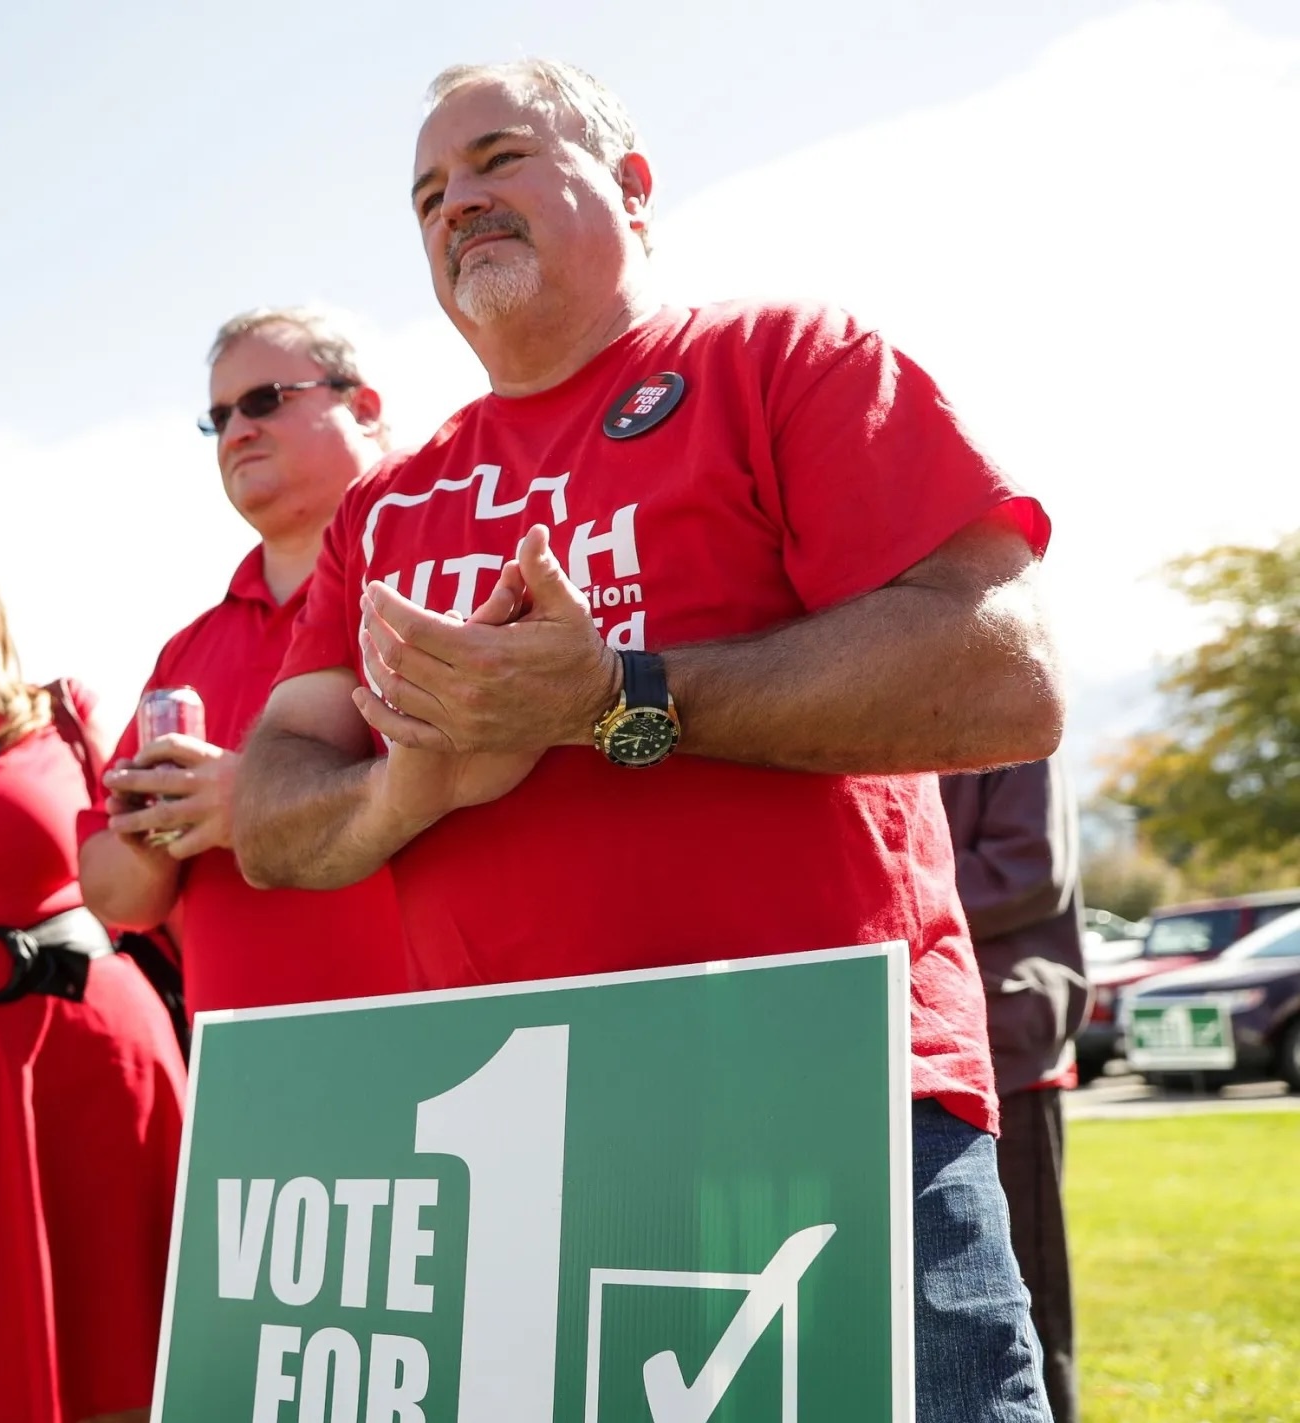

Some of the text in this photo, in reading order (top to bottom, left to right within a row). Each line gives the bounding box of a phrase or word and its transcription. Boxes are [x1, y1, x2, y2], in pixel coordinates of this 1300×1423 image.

[633, 405, 653, 415] ED
[634, 396, 661, 406] FOR
[383, 503, 641, 621] TH
[216, 1176, 439, 1313] VOTE
[414, 1024, 570, 1423] 1
[252, 1323, 430, 1423] FOR
